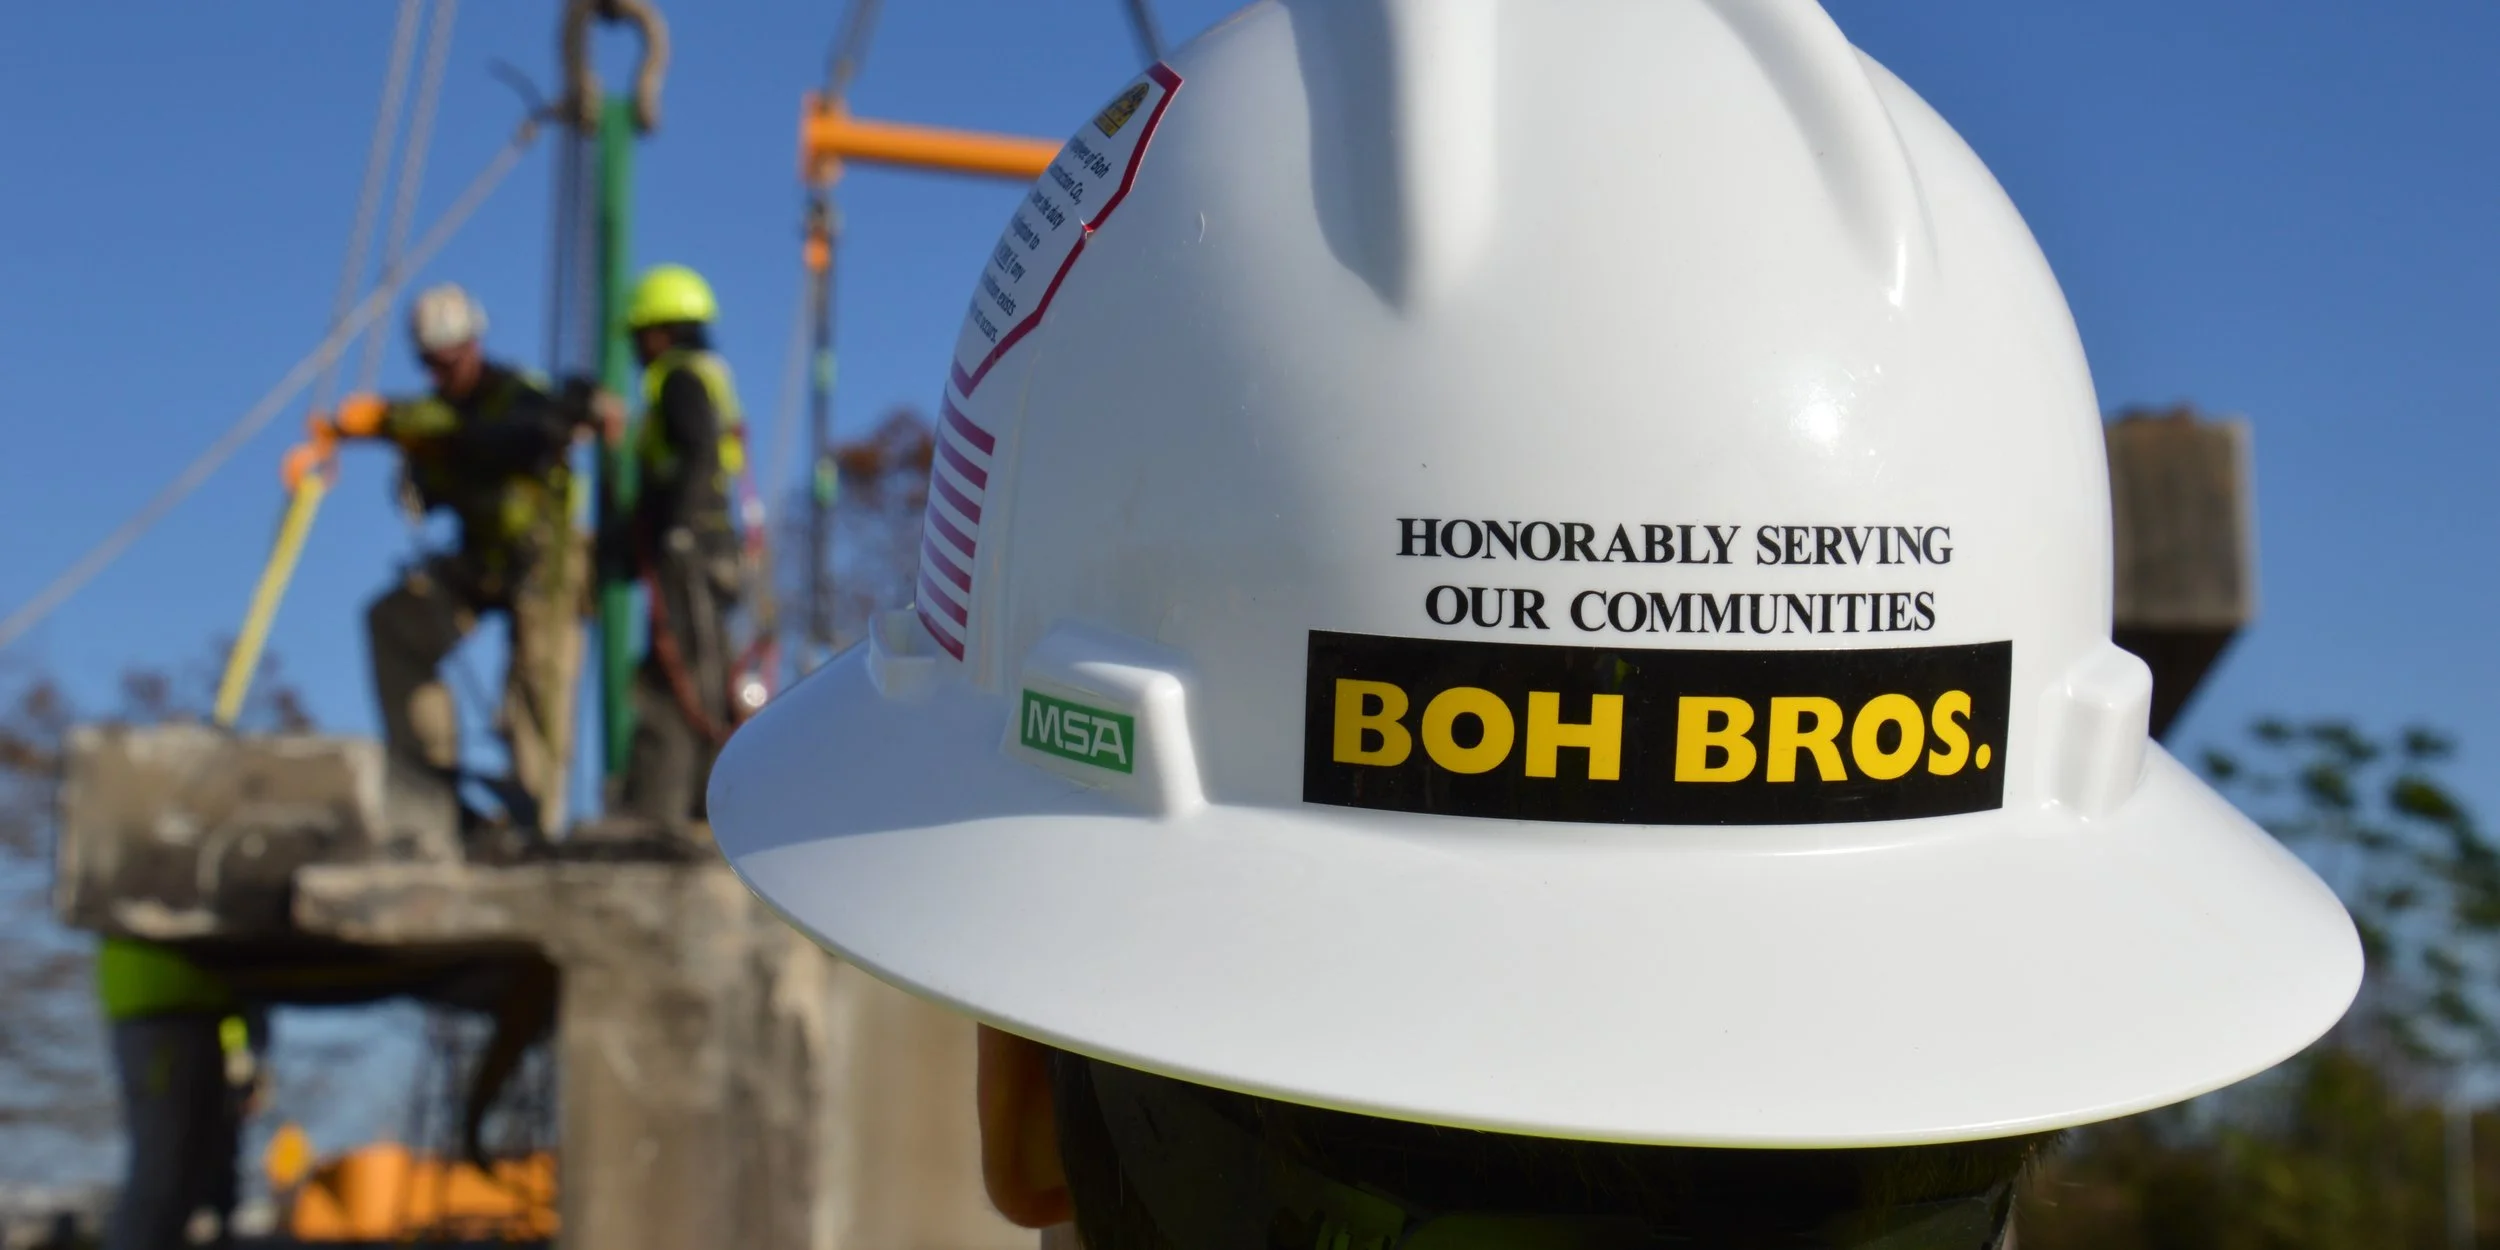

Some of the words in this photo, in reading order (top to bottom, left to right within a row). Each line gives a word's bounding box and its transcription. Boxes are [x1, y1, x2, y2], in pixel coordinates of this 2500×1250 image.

[1090, 156, 1112, 179] Boh
[1046, 204, 1066, 231] duty
[1028, 232, 1040, 251] to
[1010, 261, 1026, 284] any
[996, 291, 1017, 317] exists
[1397, 518, 1740, 565] HONORABLY
[1756, 526, 1953, 566] SERVING
[1425, 585, 1550, 631] OUR
[1570, 592, 1936, 633] COMMUNITIES
[1027, 699, 1127, 765] MSA
[1332, 678, 1623, 780] BOH
[1675, 690, 1992, 782] BROS.
